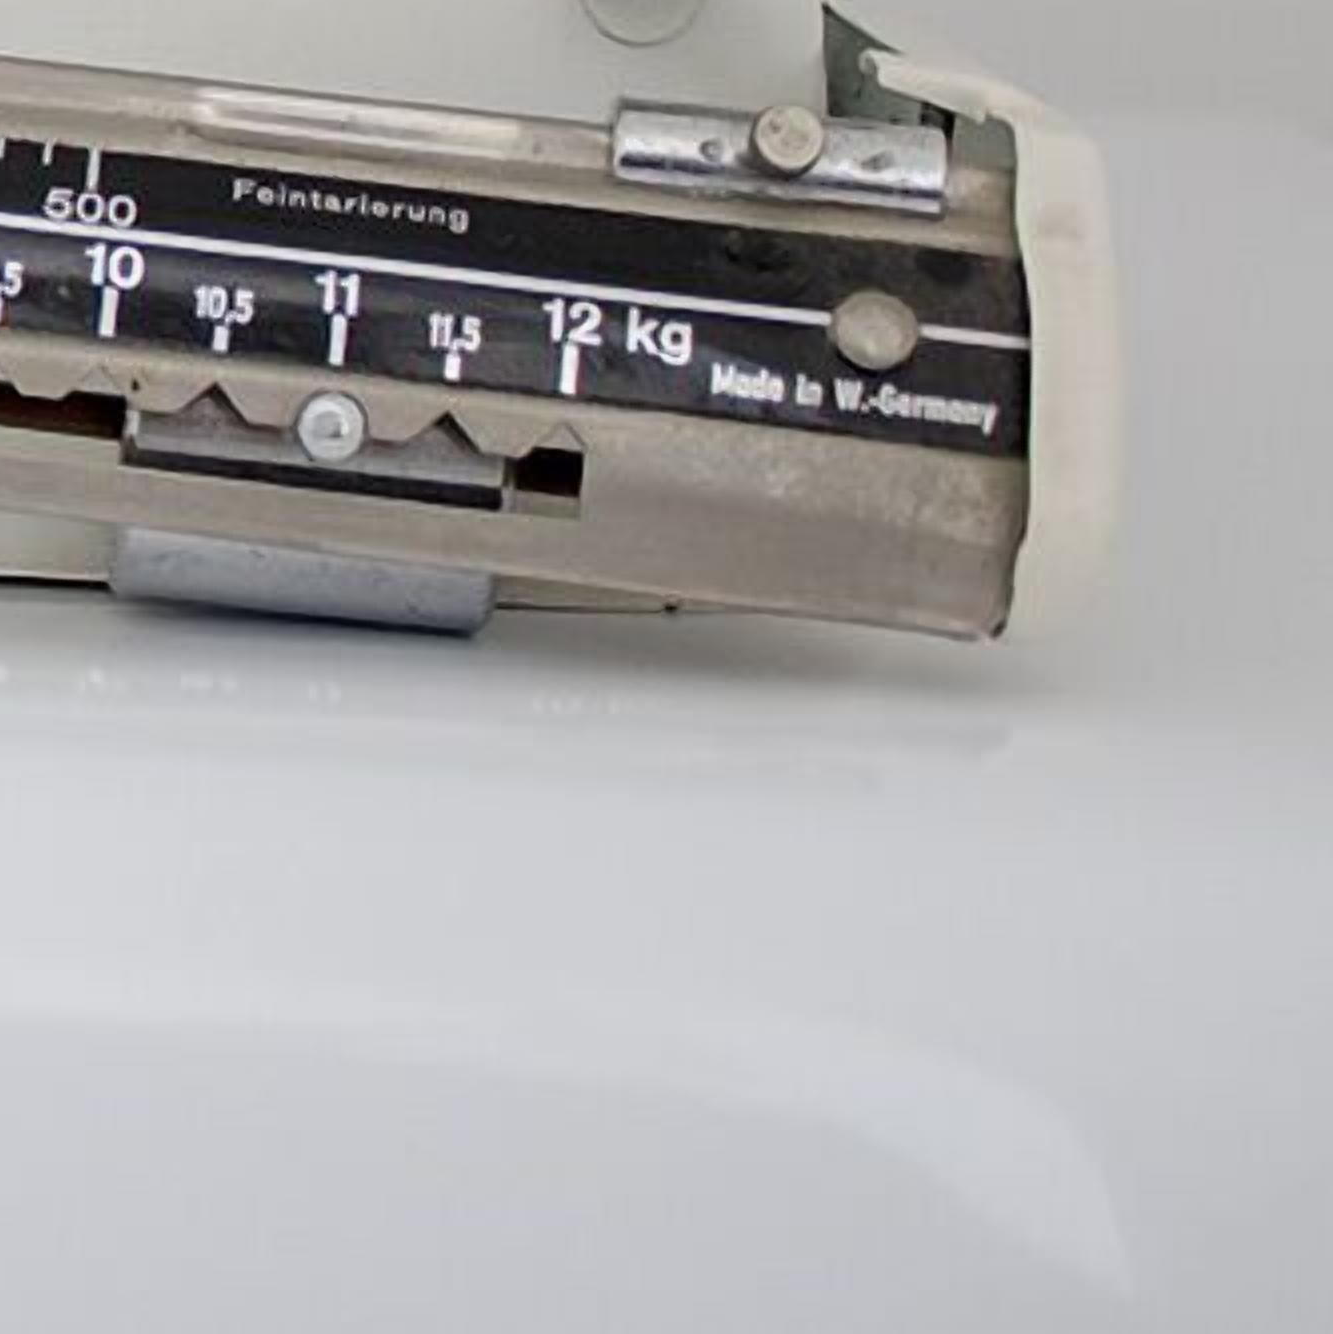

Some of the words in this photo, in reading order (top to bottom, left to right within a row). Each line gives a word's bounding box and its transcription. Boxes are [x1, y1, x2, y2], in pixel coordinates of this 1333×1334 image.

[42, 187, 137, 228] 500
[232, 175, 470, 234] Feintarierung
[83, 244, 145, 291] 10
[314, 270, 361, 316] 11
[542, 298, 602, 346] 12
[626, 308, 696, 364] kg
[711, 364, 785, 404] Made
